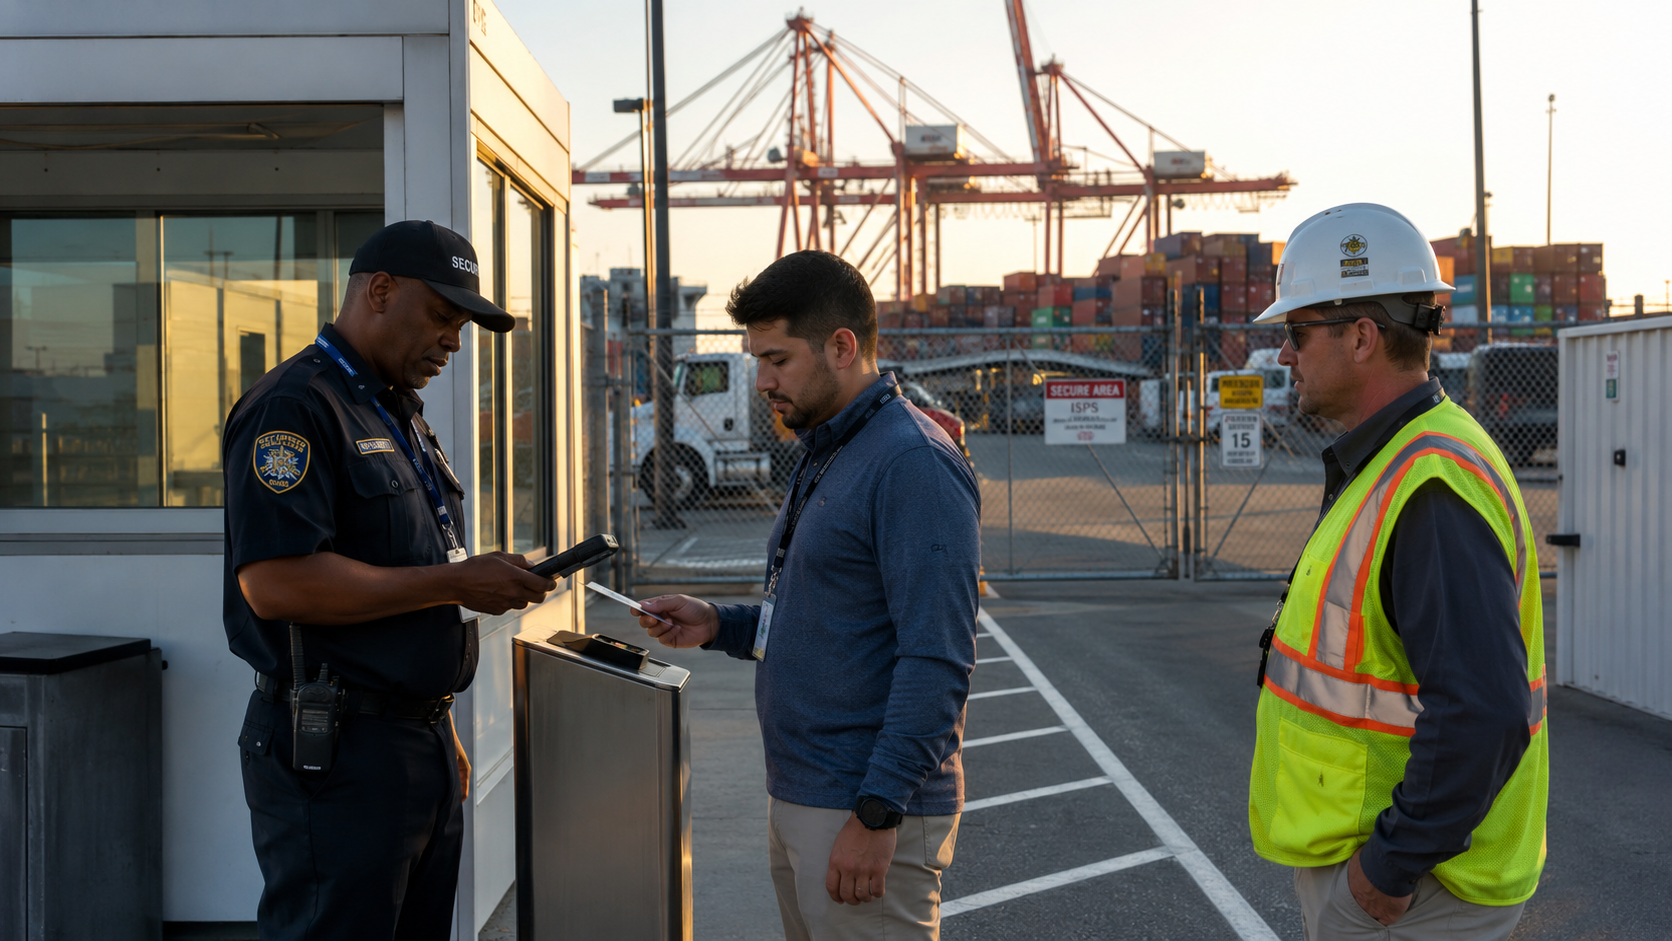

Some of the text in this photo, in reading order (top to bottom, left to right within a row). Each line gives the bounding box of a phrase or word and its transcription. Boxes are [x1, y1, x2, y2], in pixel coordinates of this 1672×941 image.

[1050, 384, 1120, 397] SECURE AREA
[1071, 402, 1099, 413] ISPS
[1232, 432, 1251, 449] 15
